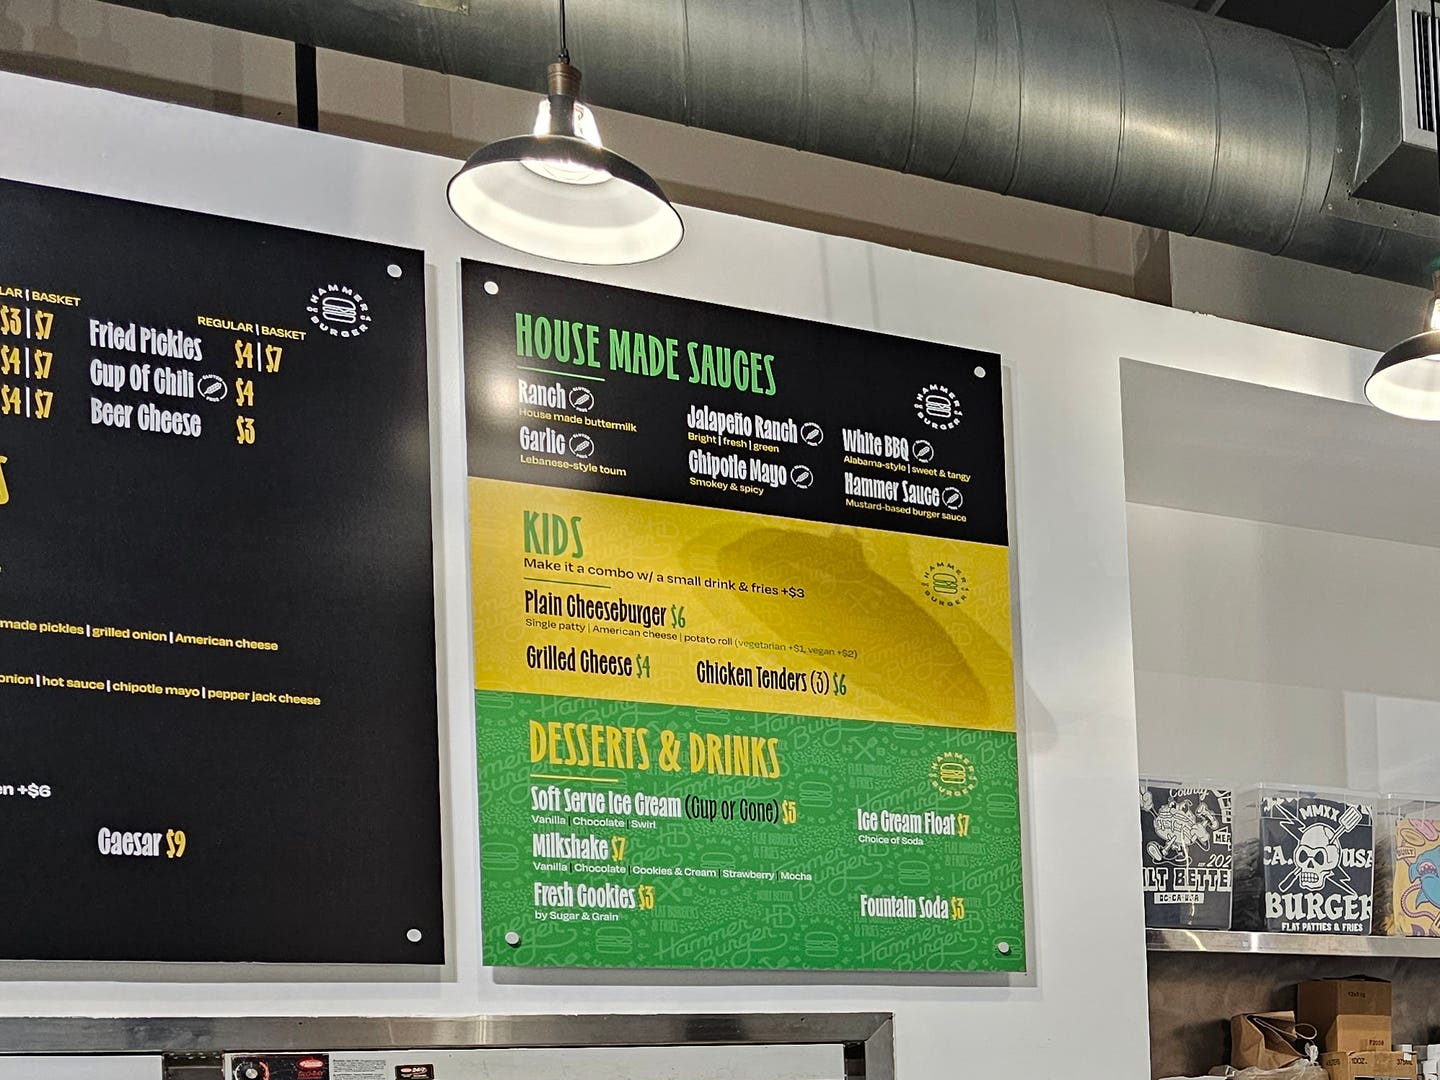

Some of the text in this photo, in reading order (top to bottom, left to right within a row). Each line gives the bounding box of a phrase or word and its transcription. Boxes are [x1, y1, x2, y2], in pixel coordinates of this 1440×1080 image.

[32, 292, 81, 306] BASKET
[197, 316, 306, 340] REGULAR BASKET
[89, 319, 283, 372] Fried Pickles $4 $7
[515, 312, 777, 396] HOUSE MADE SAUCES
[90, 359, 253, 406] Cup Of Chili $4
[518, 379, 567, 410] Ranch
[91, 397, 256, 444] Beer Cheese $3
[687, 404, 798, 443] Jalapeño Ranch
[519, 425, 566, 455] Garlic
[842, 428, 909, 461] White BBQ
[688, 449, 787, 488] Chipotle Mayo
[844, 472, 940, 507] Hammer Sauce
[524, 510, 584, 559] KIDS
[525, 589, 687, 629] Plain Cheeseburger $6
[39, 622, 278, 651] pickles grilled onion American cheese
[527, 645, 650, 678] Grilled Cheese $4
[697, 660, 847, 696] Chicken Tenders (3) $6
[42, 676, 320, 706] hot sauce chipotle mayo pepper jack cheese
[529, 719, 781, 779] DESSERTS & DRINKS
[531, 785, 797, 825] Soft Serve Ice Cream (Cup or Cone) $5
[1300, 805, 1340, 822] MMXX
[857, 809, 969, 837] Ice Cream Float $7
[98, 827, 186, 858] Caesar $9
[532, 833, 626, 862] Milkshake $7
[1281, 922, 1363, 932] FLAT PATTIES & FRIES
